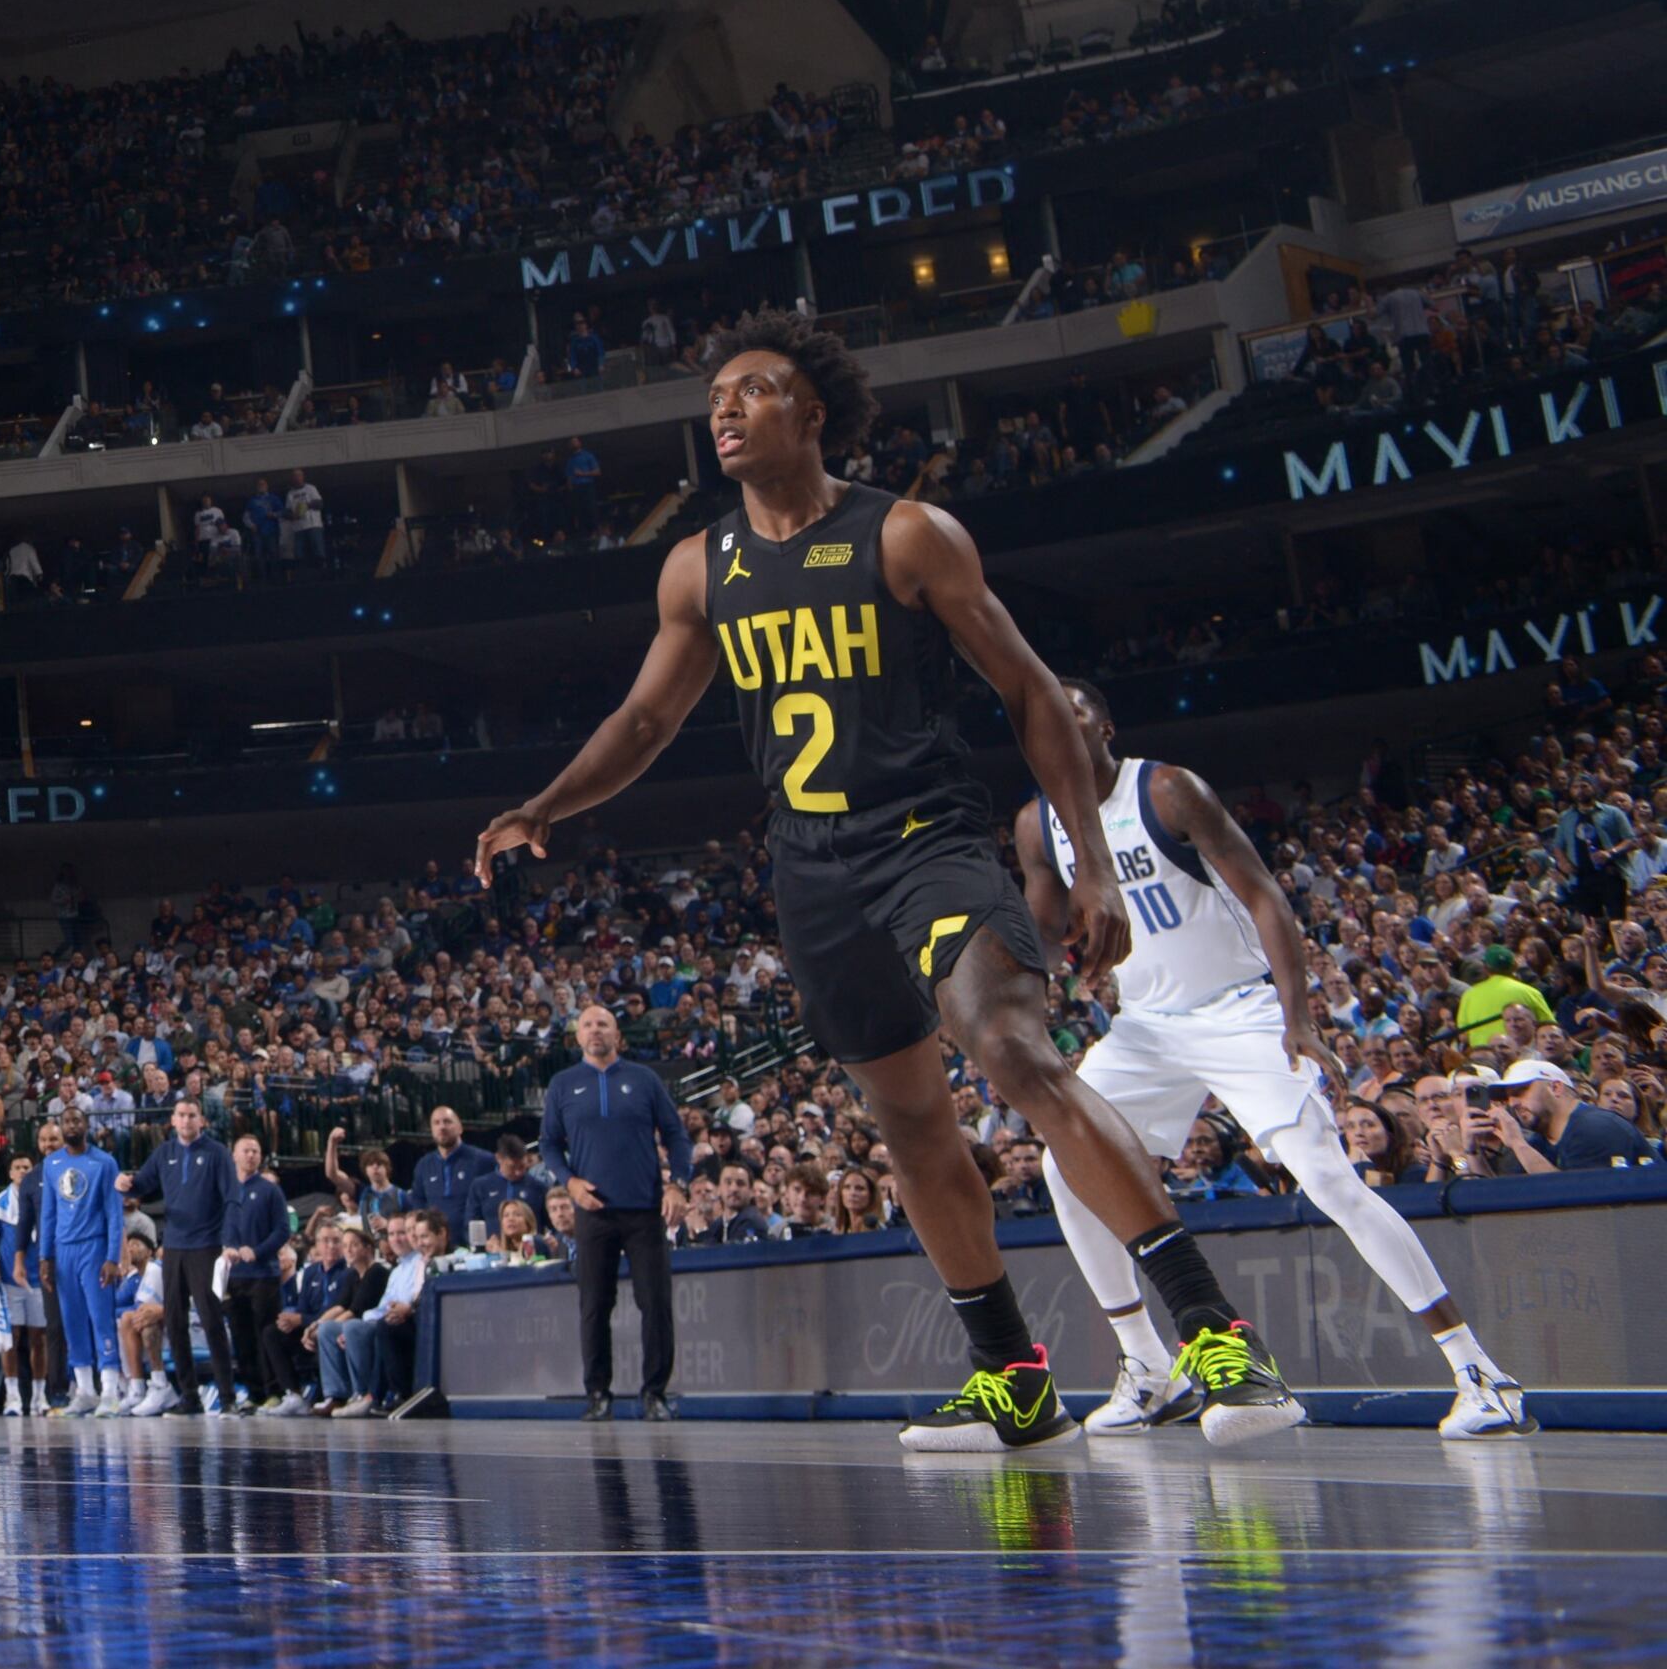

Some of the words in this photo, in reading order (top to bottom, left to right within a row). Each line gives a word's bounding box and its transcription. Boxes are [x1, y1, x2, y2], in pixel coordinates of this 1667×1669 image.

[1526, 170, 1642, 213] MUSTANG
[721, 532, 734, 552] 6
[808, 548, 823, 565] 5
[822, 554, 849, 564] FIGHT
[718, 603, 881, 692] UTAH
[772, 692, 849, 814] 2
[1127, 882, 1183, 936] 10
